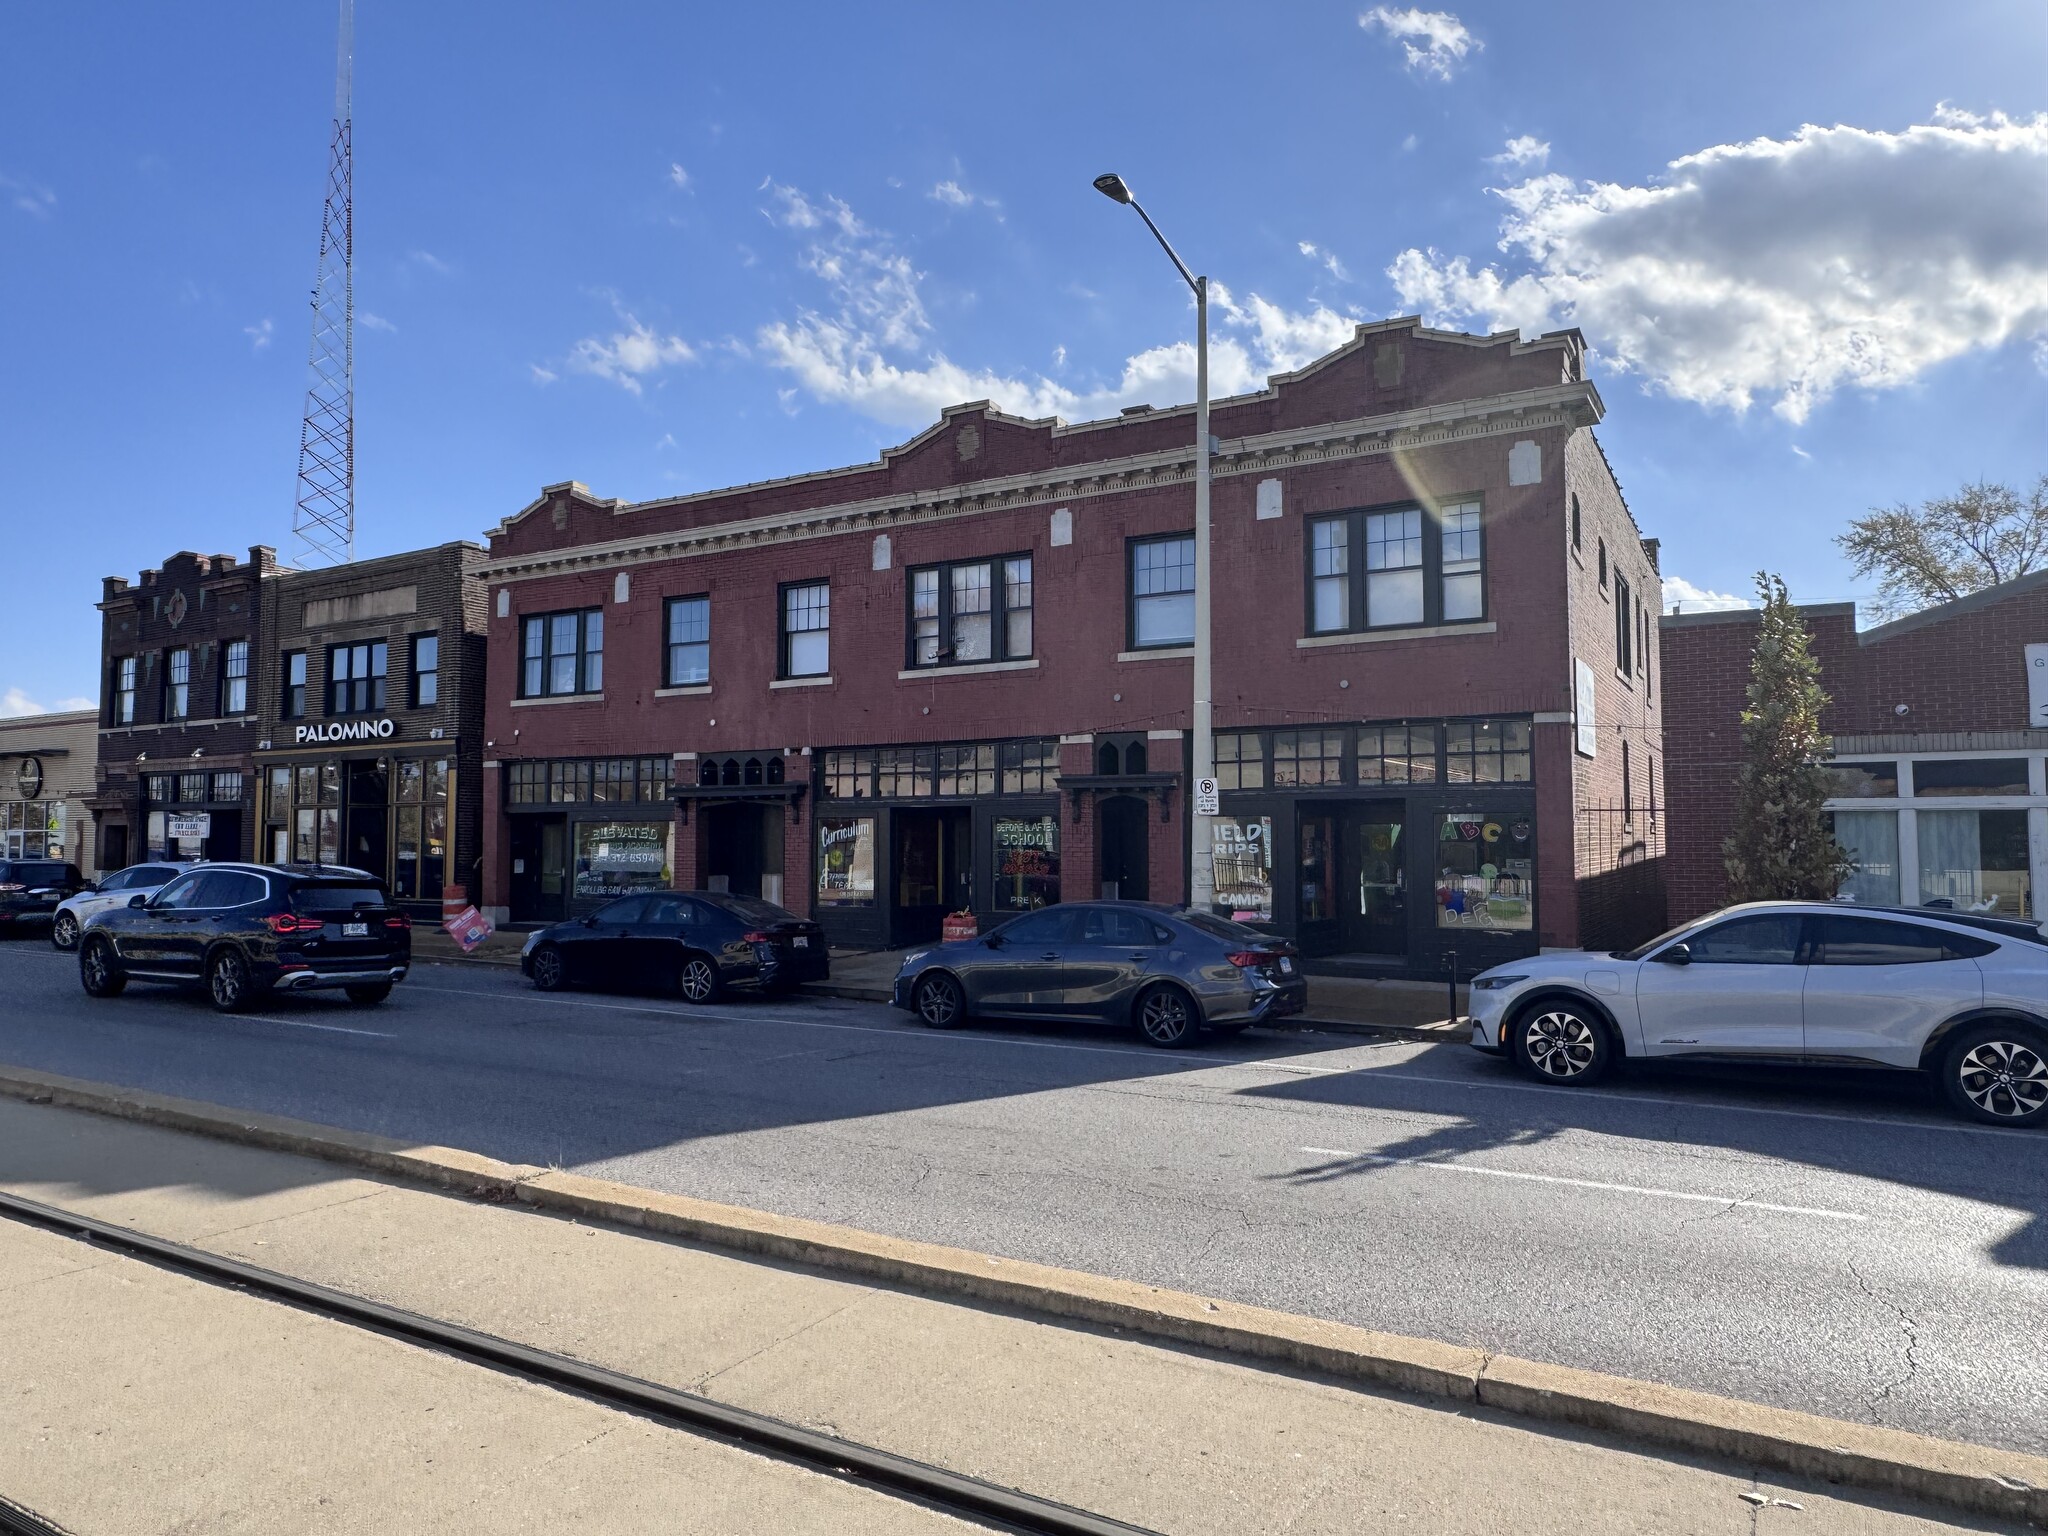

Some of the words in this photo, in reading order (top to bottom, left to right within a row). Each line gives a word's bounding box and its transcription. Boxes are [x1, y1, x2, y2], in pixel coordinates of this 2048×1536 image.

[296, 719, 394, 743] PALOMINO
[591, 826, 659, 841] ELEVATED
[822, 821, 869, 847] Curriculum
[997, 823, 1024, 832] BEFORE
[1213, 824, 1262, 842] IELD
[1002, 833, 1053, 846] SCHOOL
[1213, 843, 1260, 854] RIPS
[1010, 896, 1029, 905] PRE
[1034, 896, 1042, 905] K
[1218, 893, 1263, 906] CAMP
